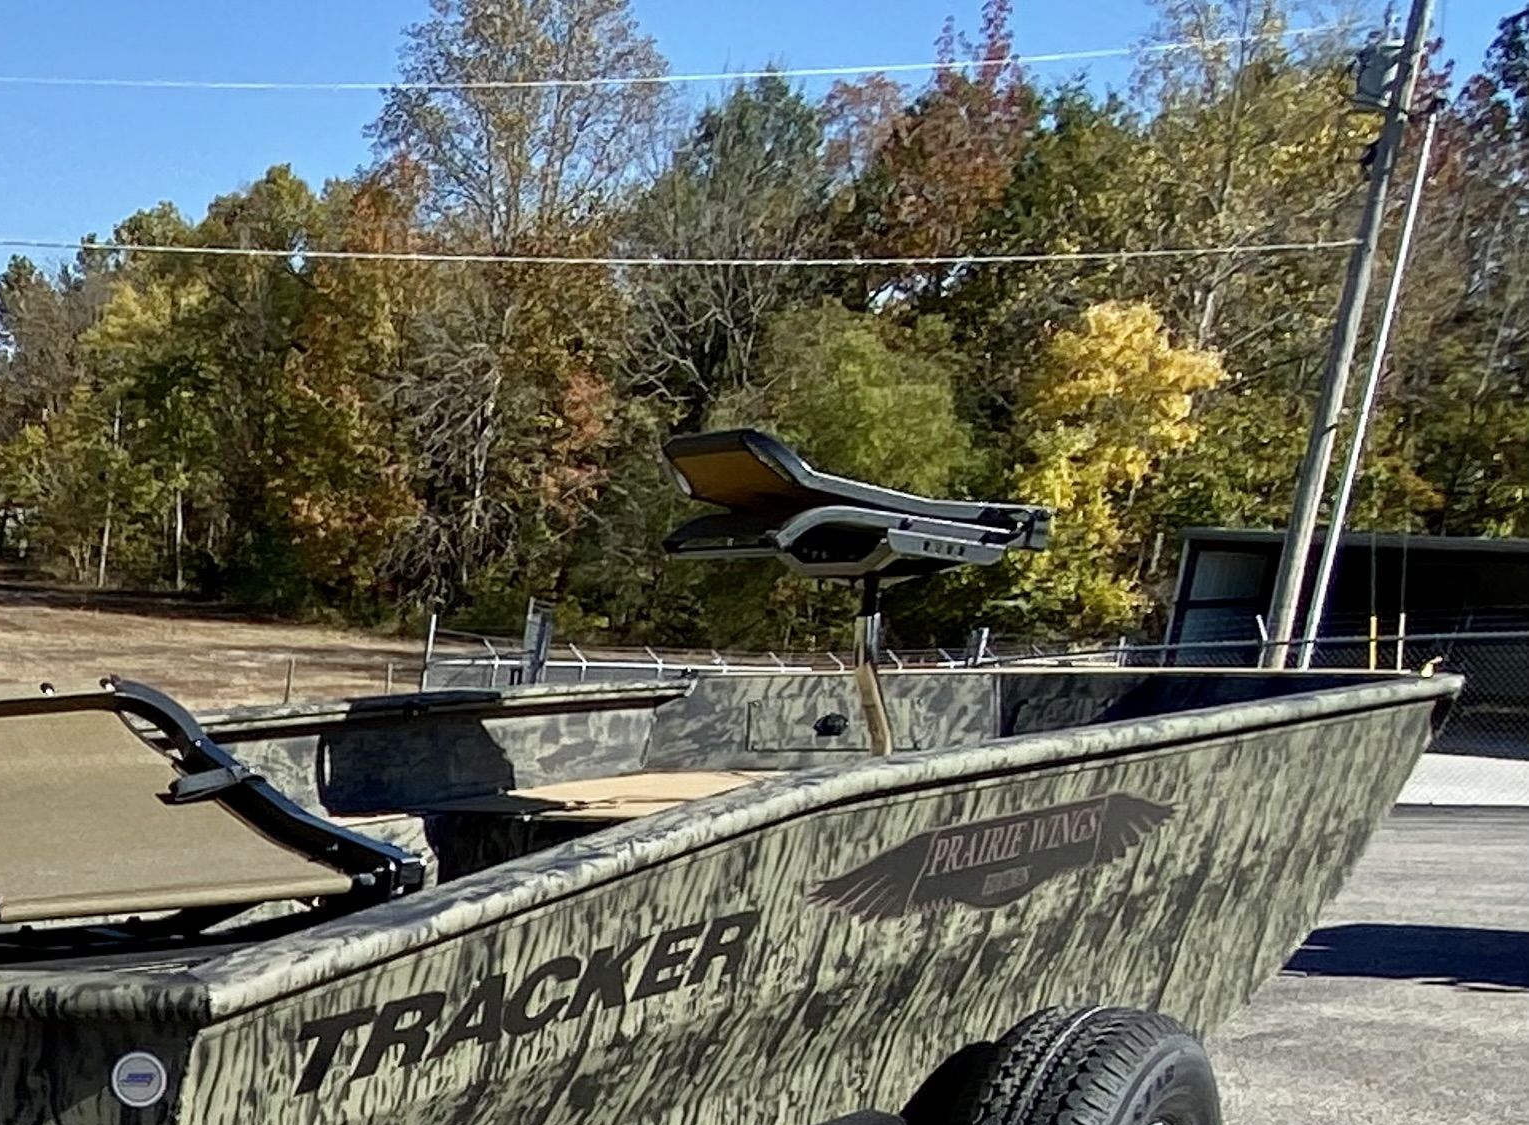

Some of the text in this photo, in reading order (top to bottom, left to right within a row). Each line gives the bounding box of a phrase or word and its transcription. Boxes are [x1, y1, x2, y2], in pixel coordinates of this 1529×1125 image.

[927, 807, 1100, 877] PRAIRIE WINGS
[294, 911, 761, 1097] TRACKER
